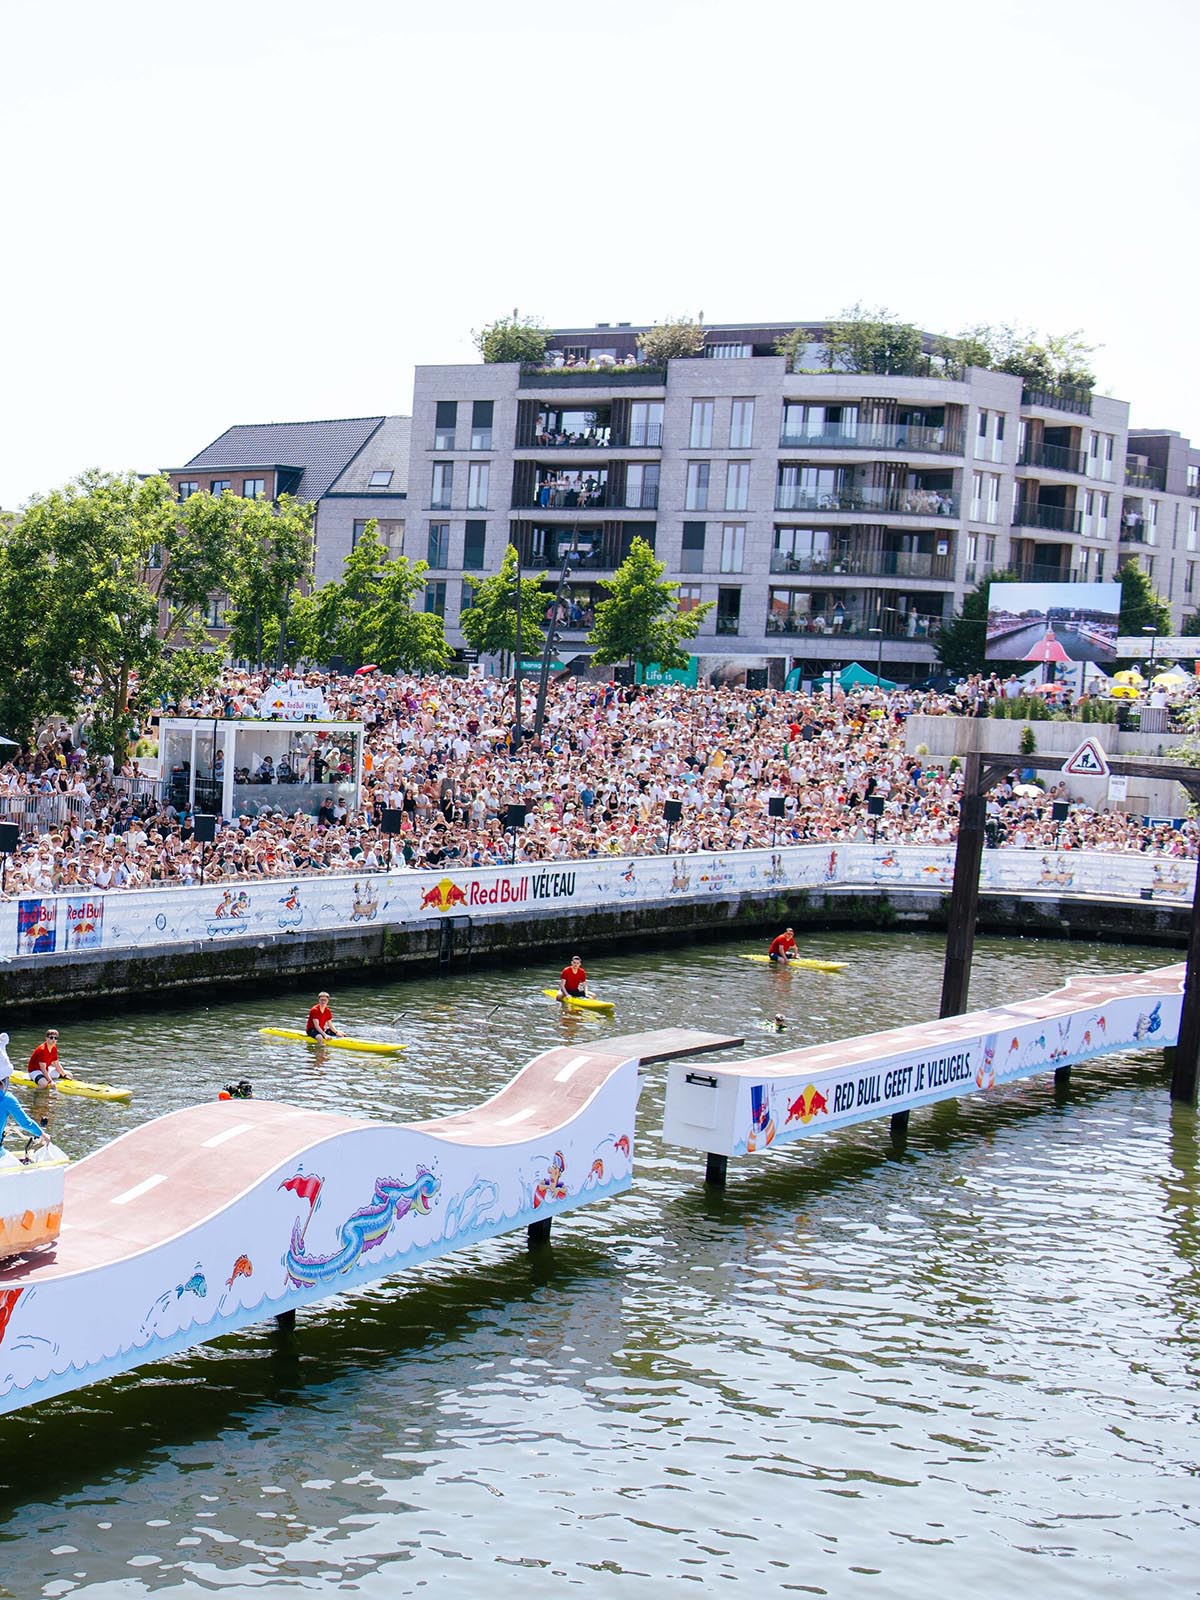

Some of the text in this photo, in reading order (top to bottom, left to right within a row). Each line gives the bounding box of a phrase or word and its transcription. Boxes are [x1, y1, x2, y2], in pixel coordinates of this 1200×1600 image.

[646, 671, 672, 681] Life is
[470, 878, 499, 905] Red
[501, 876, 528, 902] Bull
[68, 903, 85, 920] Red
[833, 1052, 972, 1113] RED BULL GEEFT JE VLEUGELS.
